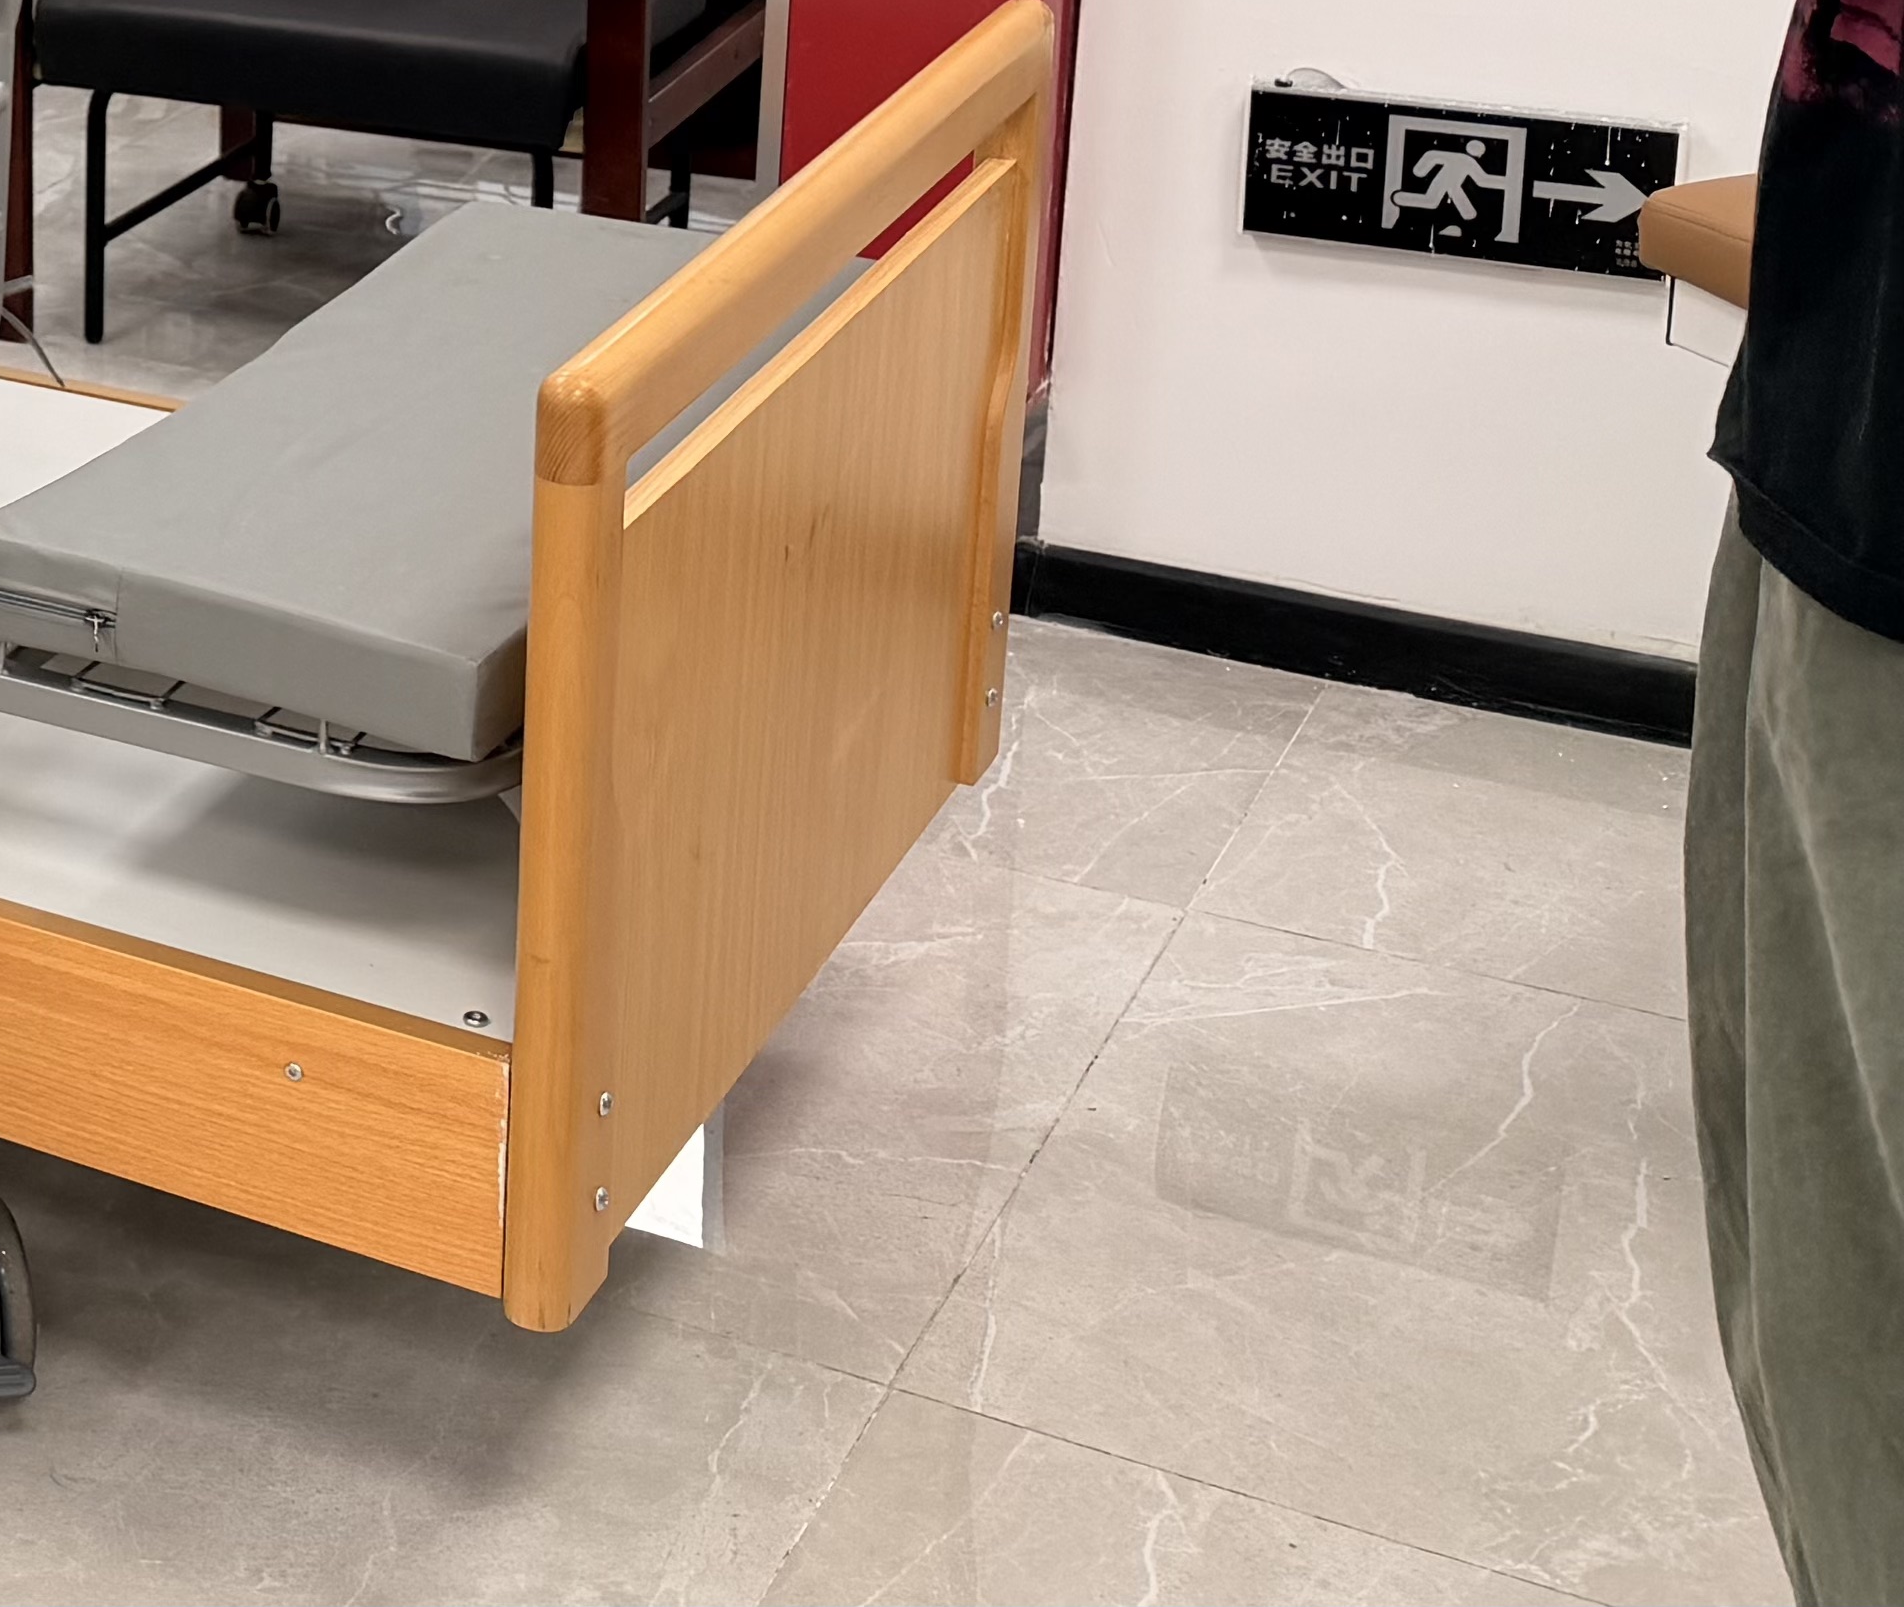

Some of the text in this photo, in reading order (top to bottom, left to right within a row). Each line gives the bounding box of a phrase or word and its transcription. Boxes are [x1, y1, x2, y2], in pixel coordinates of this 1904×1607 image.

[1265, 137, 1375, 170] 安全出口
[1270, 163, 1368, 192] EXIT
